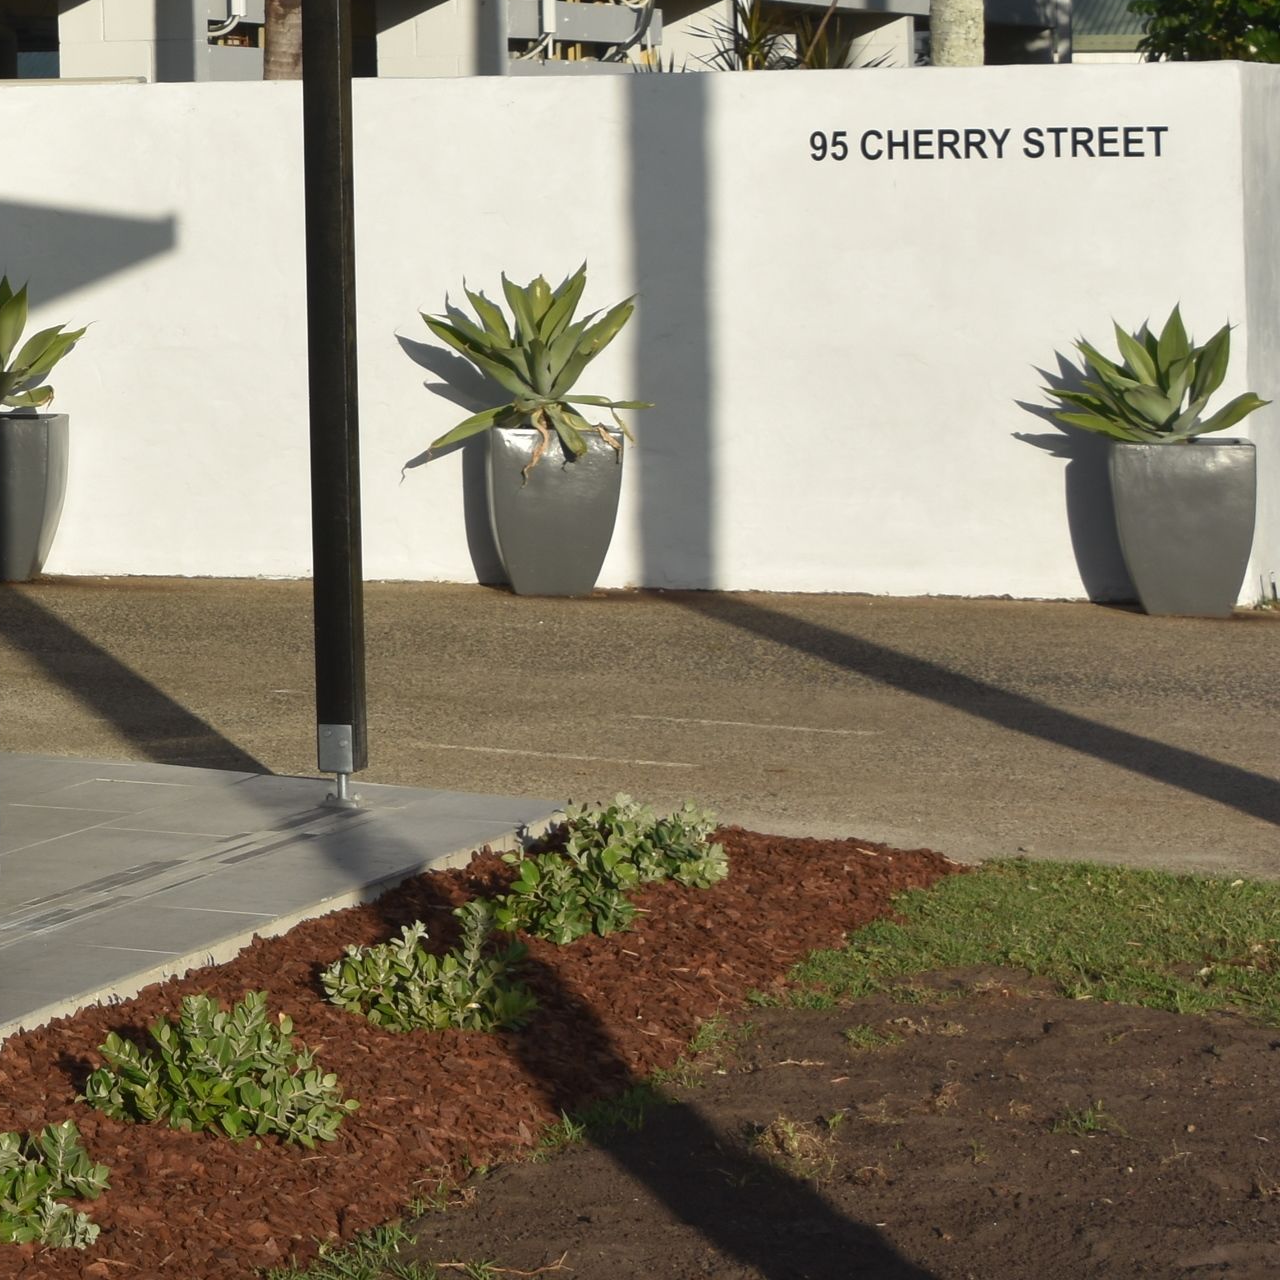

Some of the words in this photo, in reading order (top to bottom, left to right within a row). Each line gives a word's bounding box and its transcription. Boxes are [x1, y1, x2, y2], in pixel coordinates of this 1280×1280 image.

[809, 130, 849, 161] 95
[860, 128, 1011, 160] CHERRY
[1022, 126, 1169, 158] STREET
